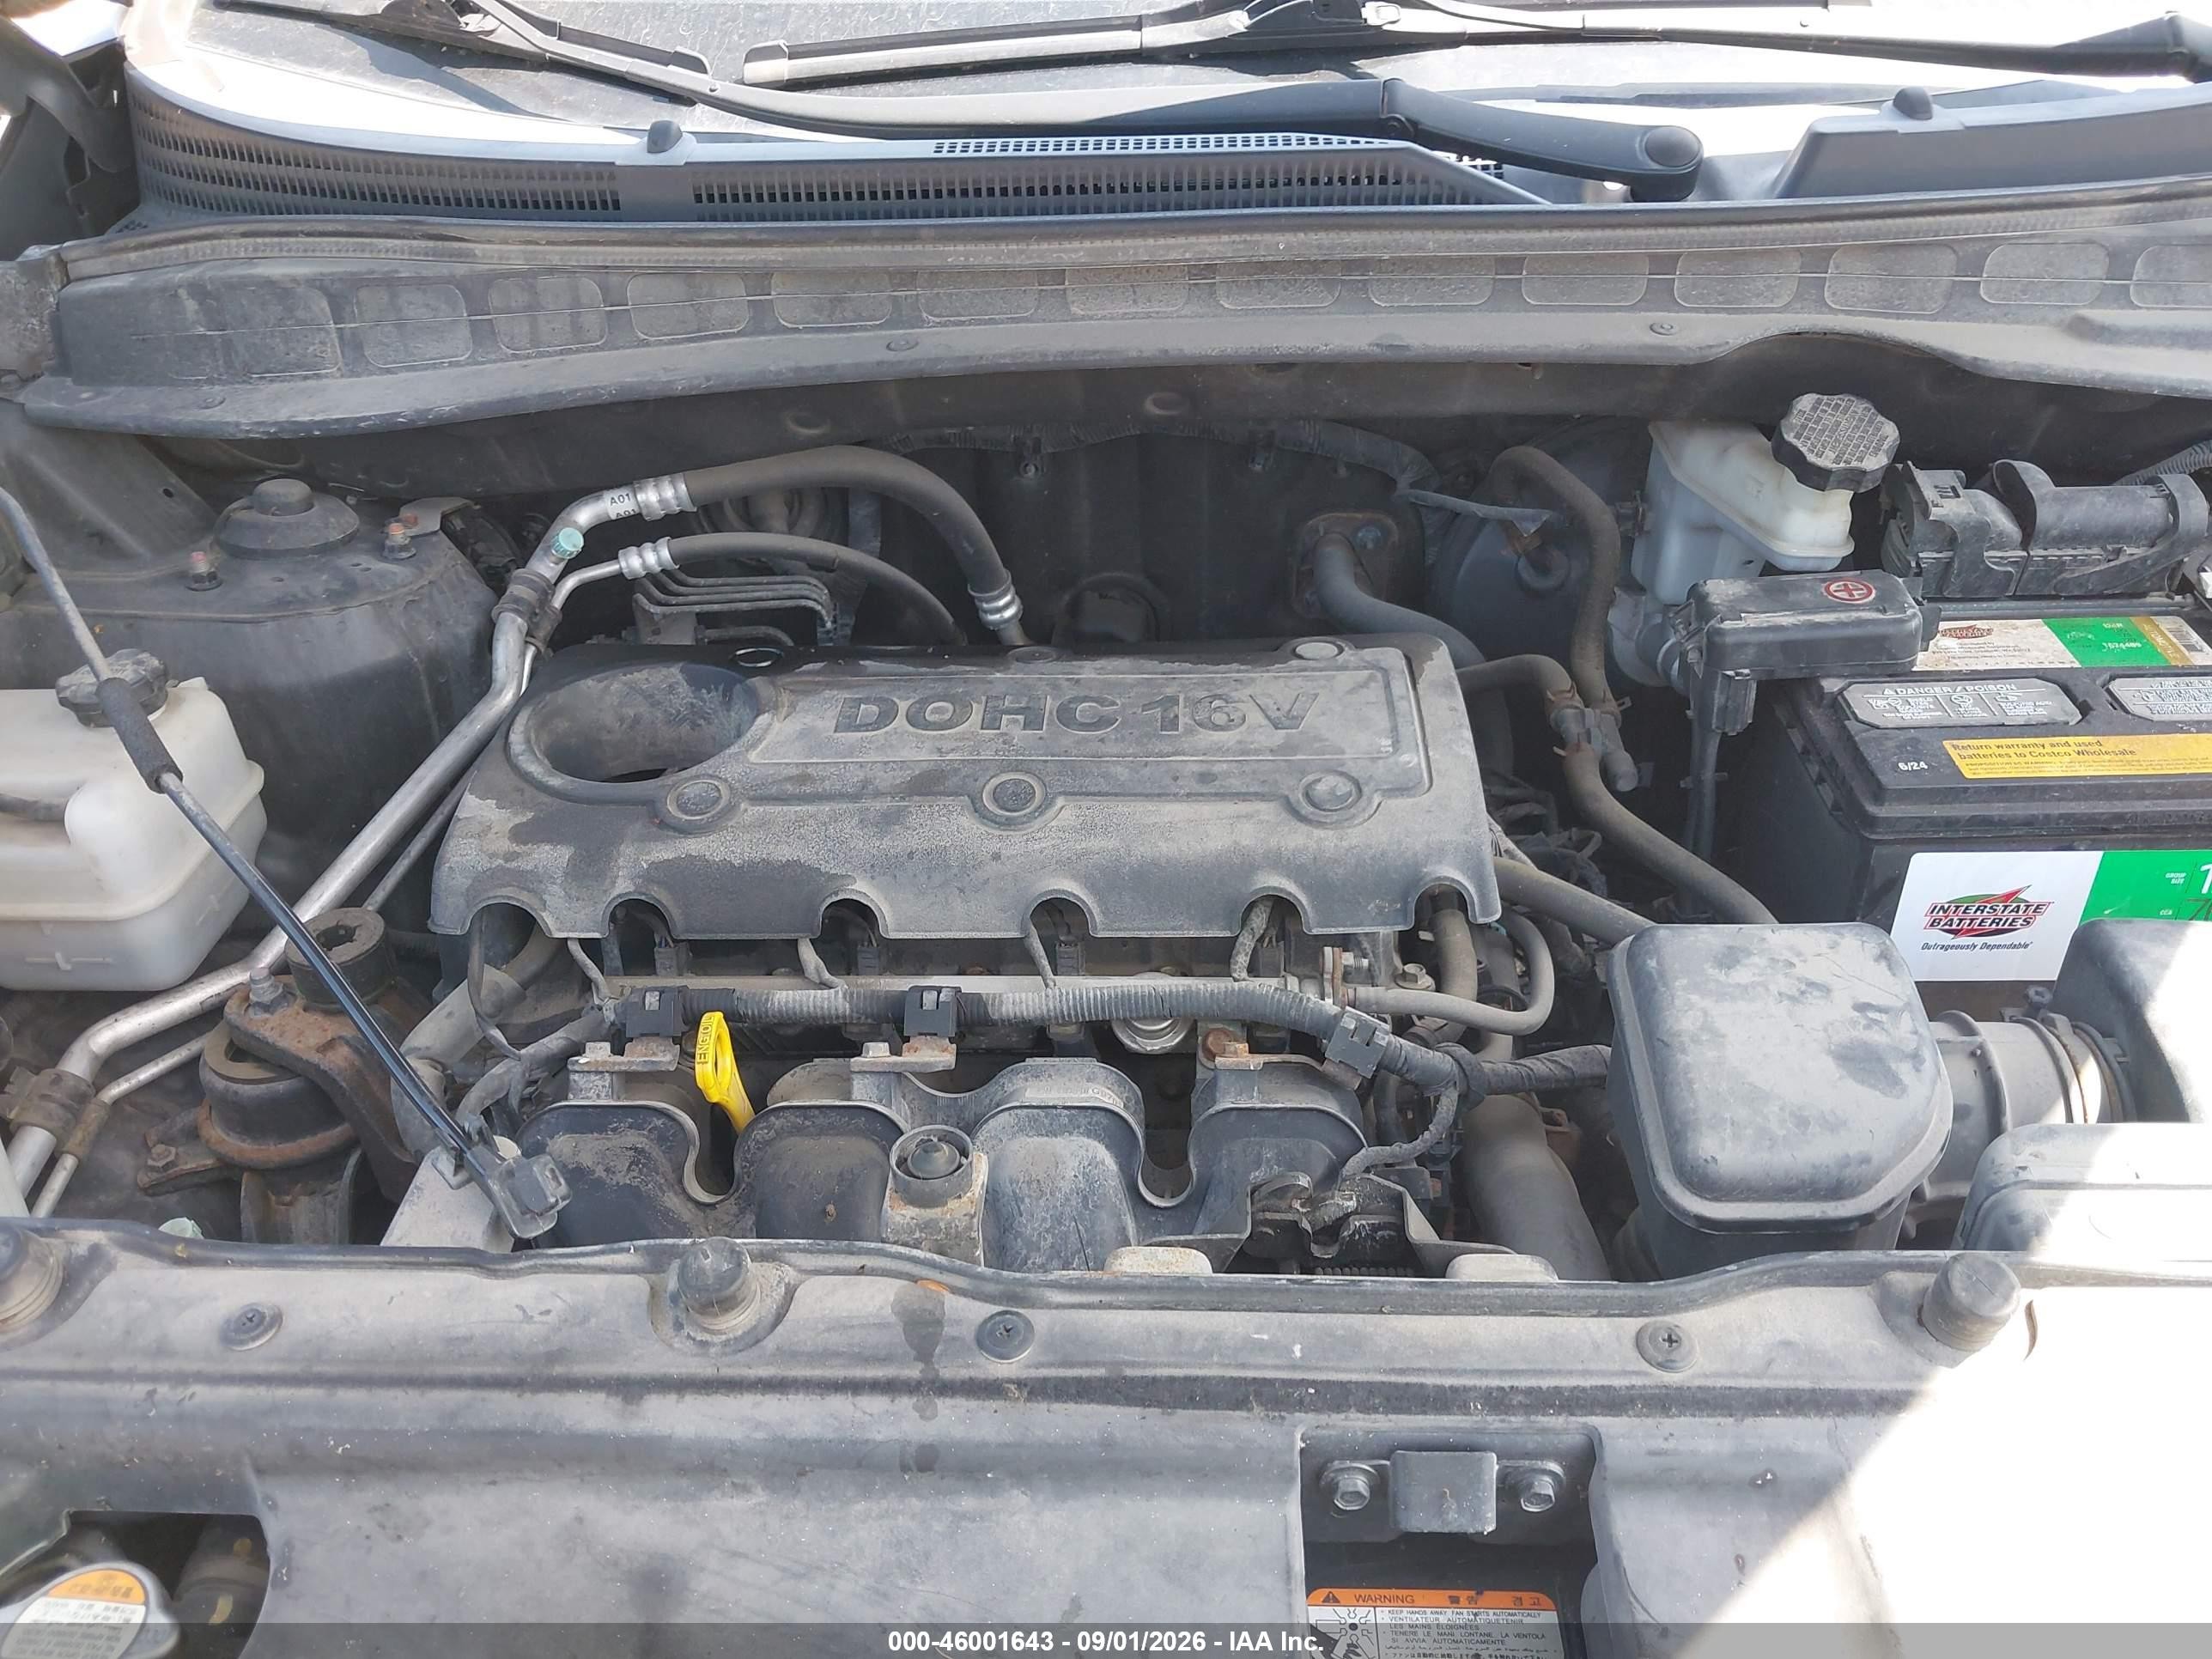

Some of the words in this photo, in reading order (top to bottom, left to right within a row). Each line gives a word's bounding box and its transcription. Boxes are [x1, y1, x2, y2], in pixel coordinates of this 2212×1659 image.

[610, 493, 631, 507] A01
[1895, 686, 1952, 695] DANGER
[833, 694, 1122, 734] DOHC
[1142, 692, 1319, 734] 16V
[1996, 741, 2045, 750] warranty
[1958, 751, 2012, 760] batteries
[1898, 761, 1929, 771] 6/24
[1929, 903, 2045, 915] INTERSTATE
[1929, 916, 2033, 928] BATTERIES
[1921, 942, 1978, 951] Outrageously
[1354, 1594, 1415, 1604] WARNING
